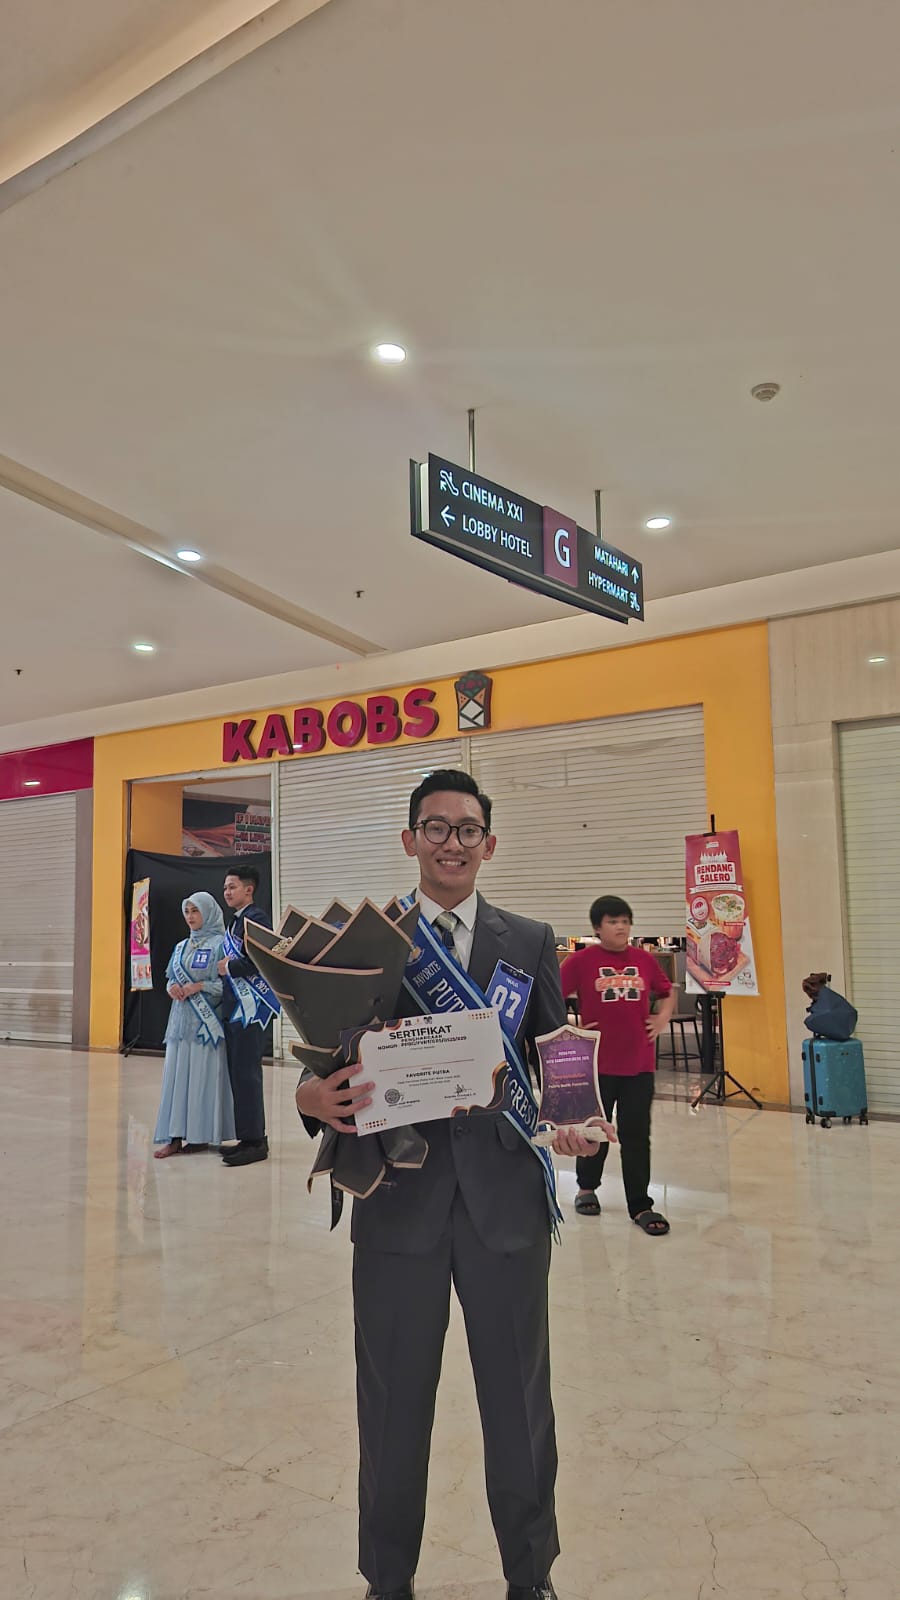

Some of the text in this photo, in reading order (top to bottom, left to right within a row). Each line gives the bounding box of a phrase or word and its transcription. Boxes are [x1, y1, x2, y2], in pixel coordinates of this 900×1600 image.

[462, 481, 523, 523] CINEMA XXI
[462, 514, 532, 558] LOBBY HOTEL
[554, 528, 570, 568] G
[594, 545, 629, 577] MATAHARI
[588, 570, 629, 603] HYPERMART
[223, 688, 440, 762] KABOBS
[697, 863, 733, 875] RENDANG
[700, 872, 731, 883] SALERO
[195, 954, 208, 963] 12
[412, 960, 441, 988] FAVORITE
[427, 978, 469, 1013] PUT
[491, 984, 522, 1019] 07
[389, 1025, 452, 1040] SERTIFIKAT
[509, 1078, 537, 1135] GRESI
